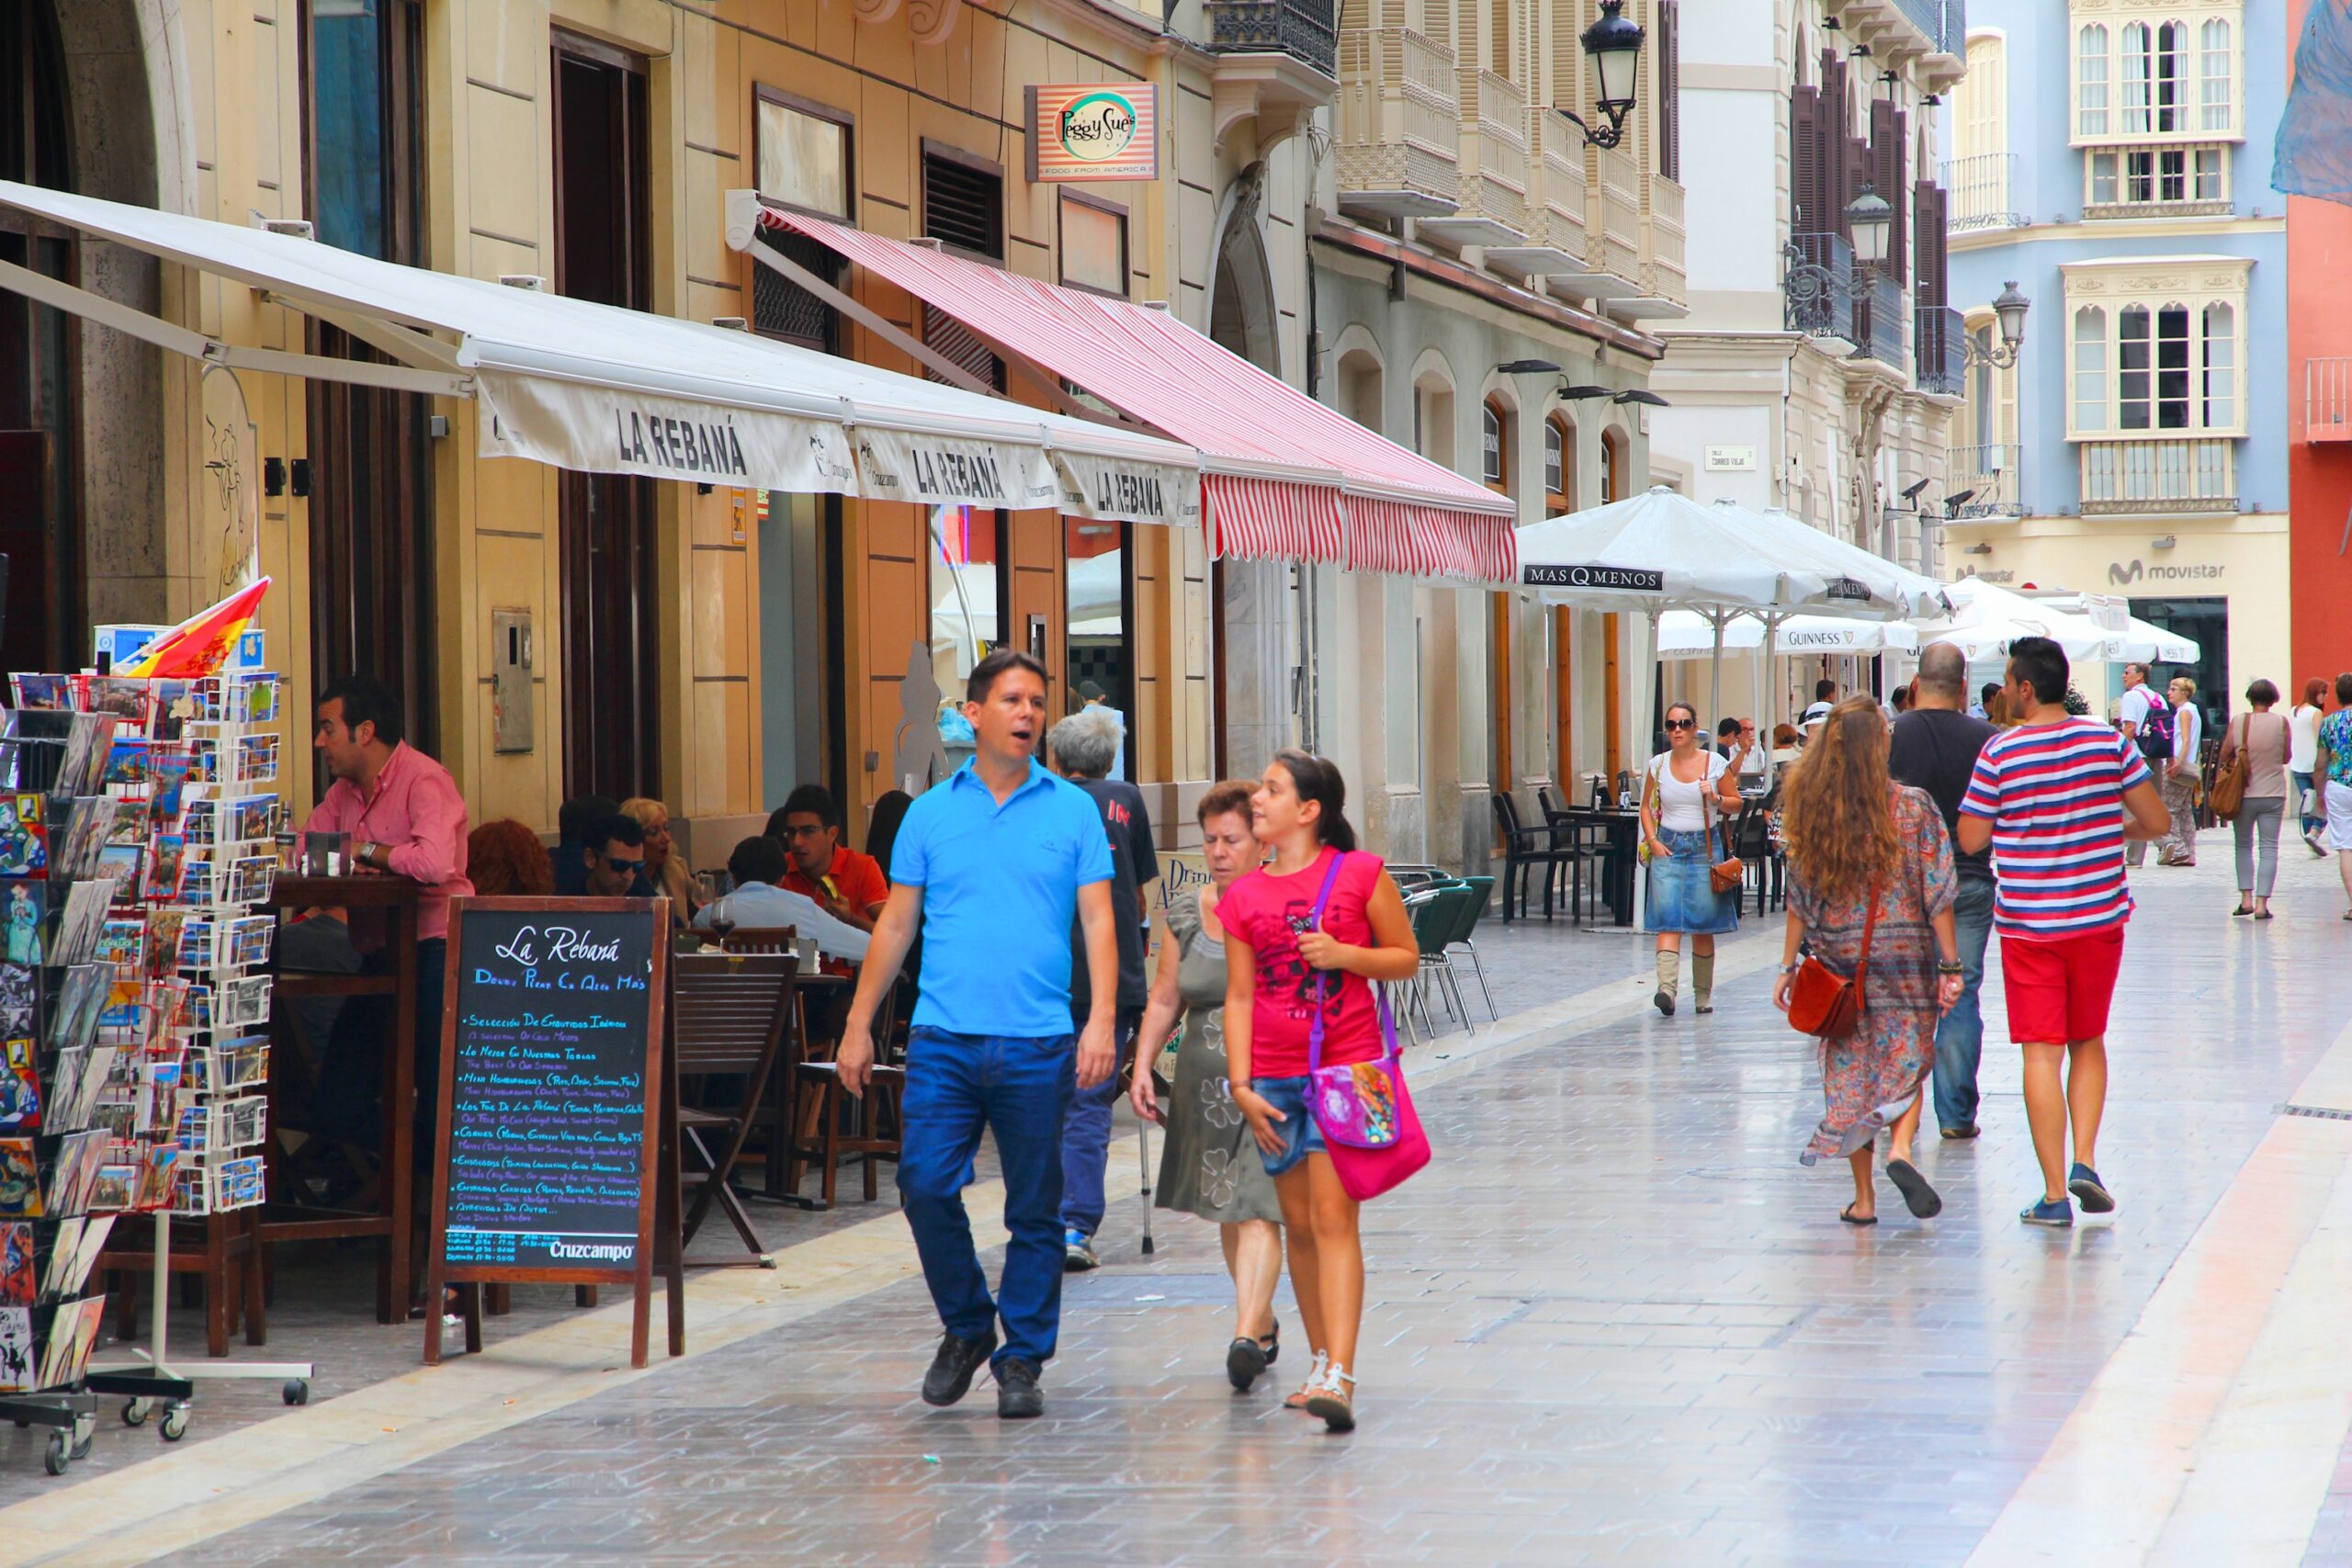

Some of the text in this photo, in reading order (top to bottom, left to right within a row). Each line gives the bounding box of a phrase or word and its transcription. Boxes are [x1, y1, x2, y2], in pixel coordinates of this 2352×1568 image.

[1059, 107, 1136, 142] Peggy Sue's
[616, 408, 747, 476] LA REBANÁ
[911, 447, 1005, 499] LA REBANÁ
[1096, 468, 1163, 516] LA REBANÁ
[1530, 567, 1657, 588] MAS Q MENOS
[2149, 564, 2224, 580] movistar
[1789, 632, 1840, 646] GUINNESS
[1169, 859, 1212, 892] Drin
[495, 926, 620, 965] La Rebaná
[549, 1240, 632, 1262] Cruzcampo
